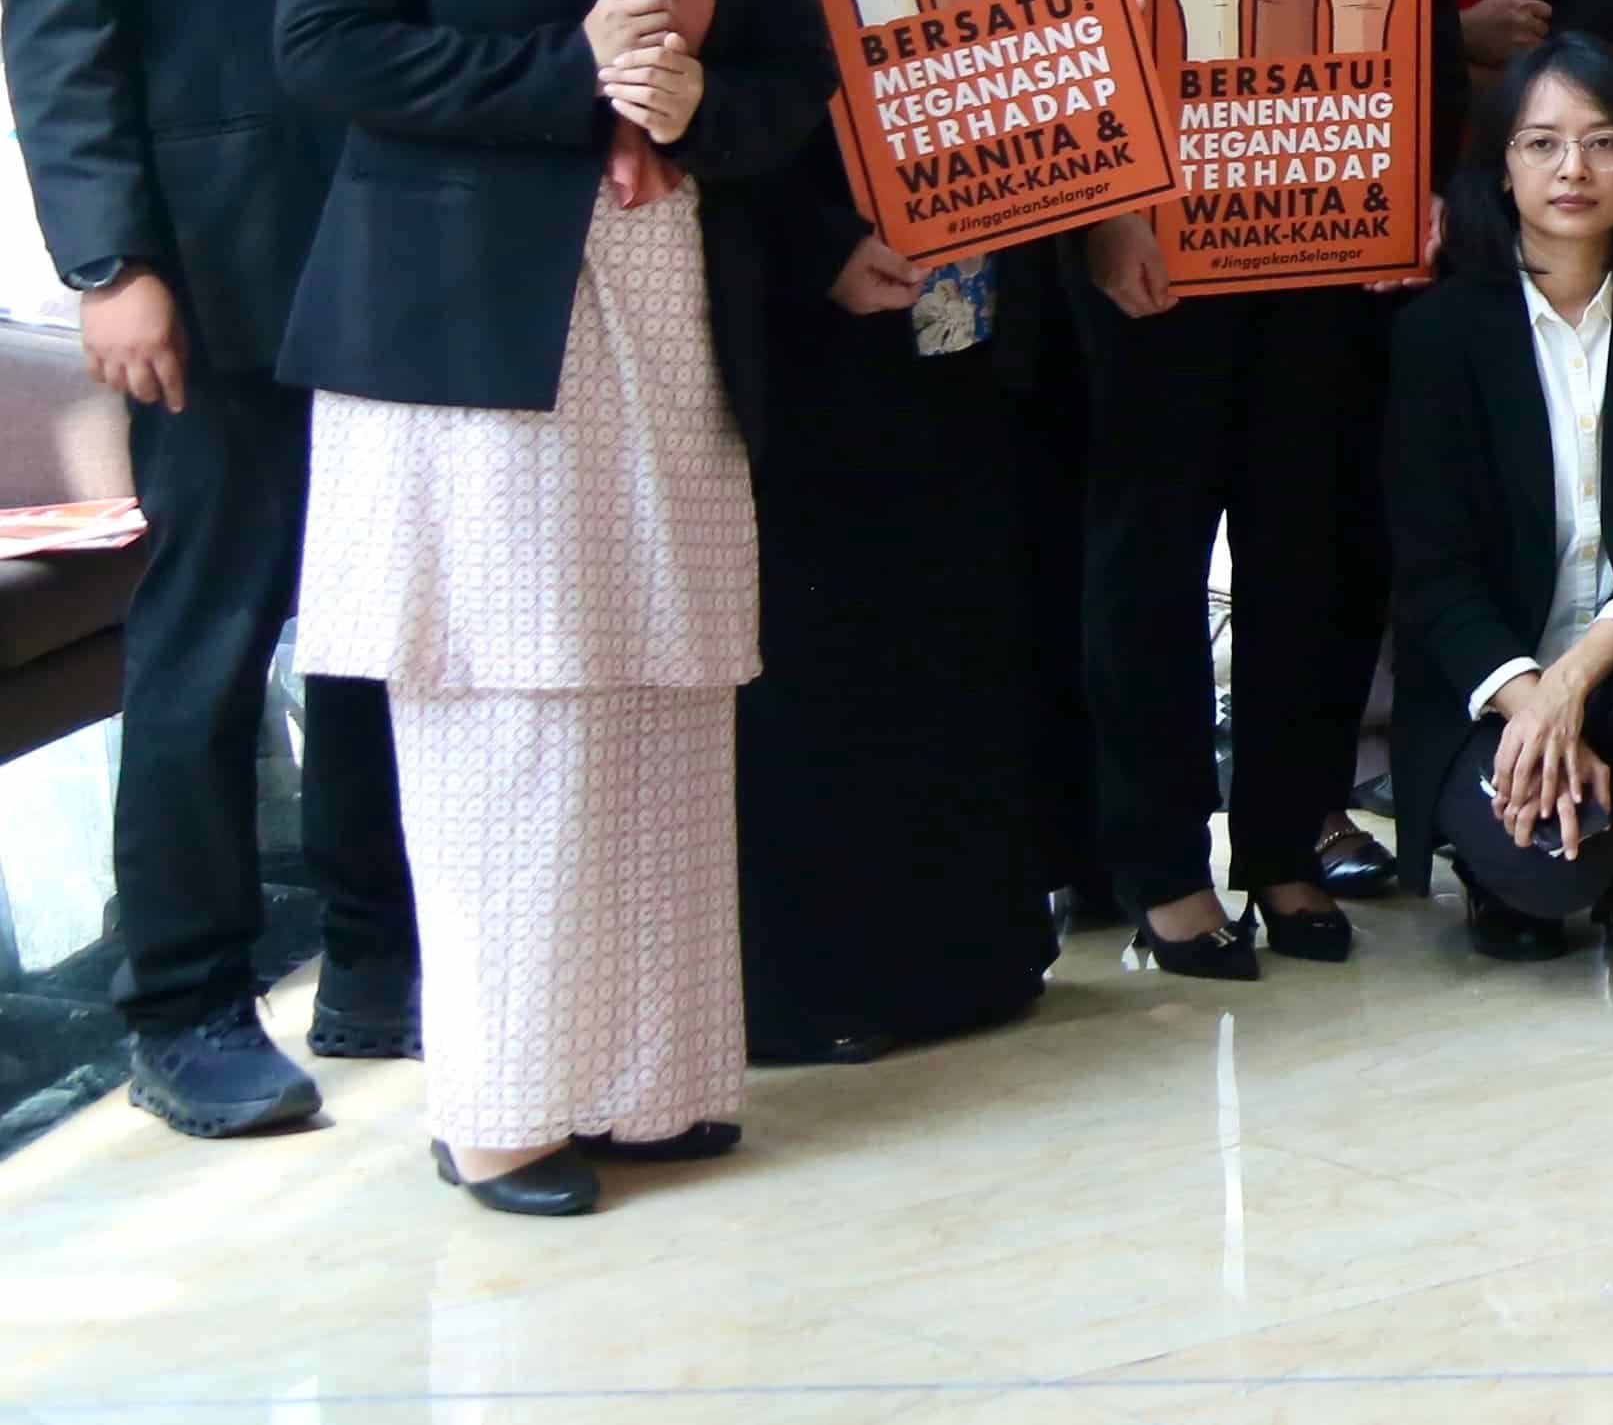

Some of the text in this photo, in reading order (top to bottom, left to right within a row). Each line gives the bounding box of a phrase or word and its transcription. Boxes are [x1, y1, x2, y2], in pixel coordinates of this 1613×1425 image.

[873, 15, 1104, 100] MENENTANG
[878, 46, 1111, 131] KEGANASAN
[1180, 59, 1393, 100] BERSATU!
[886, 77, 1117, 161] TERHADAP
[1179, 91, 1394, 131] MENENTANG
[896, 108, 1128, 195] WANITA &
[1179, 123, 1392, 162] KEGANASAN
[904, 142, 1136, 224] KANAK-KANAK
[1181, 153, 1392, 191] TERHADAP
[947, 181, 1111, 235] #JinggakanSelangor
[1182, 182, 1391, 225] WANITA &
[1179, 215, 1391, 252] KANAK-KANAK
[1210, 247, 1365, 272] #JinggakanSelangor
